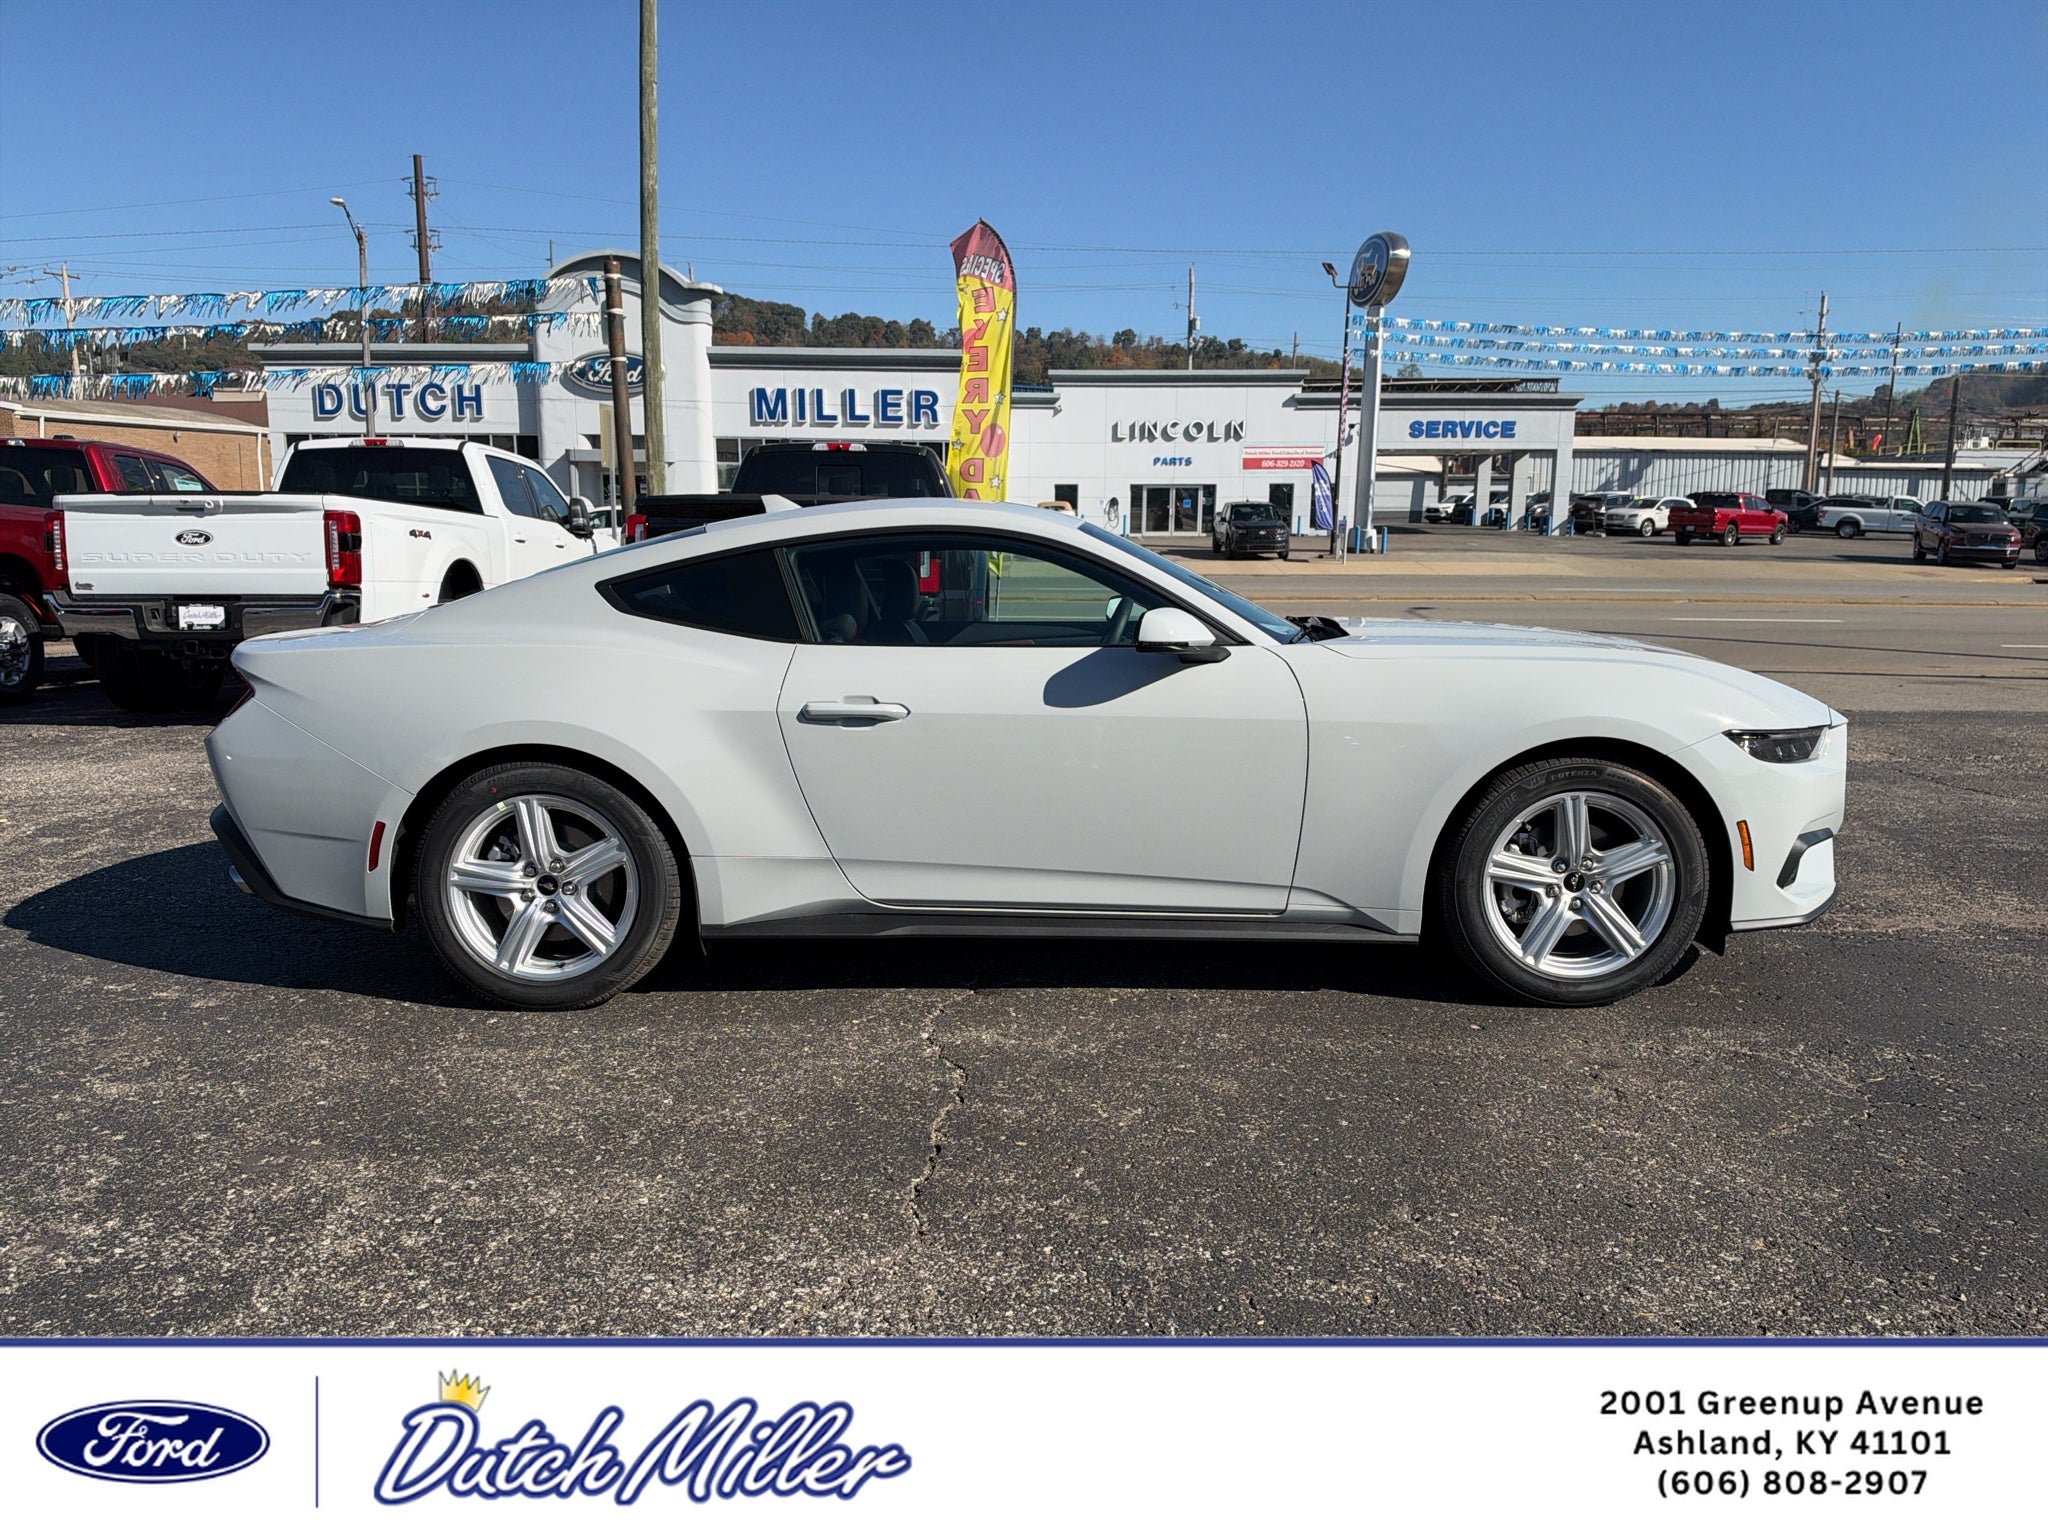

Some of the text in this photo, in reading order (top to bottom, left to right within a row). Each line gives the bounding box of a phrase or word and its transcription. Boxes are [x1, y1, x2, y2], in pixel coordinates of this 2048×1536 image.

[314, 383, 485, 420] DUTCH
[751, 387, 940, 426] MILLER
[1114, 419, 1247, 441] LINCOLN
[1408, 420, 1517, 439] SERVICE
[1153, 456, 1192, 467] PARTS
[180, 531, 207, 546] Ford
[81, 552, 311, 563] SUPER DUTY
